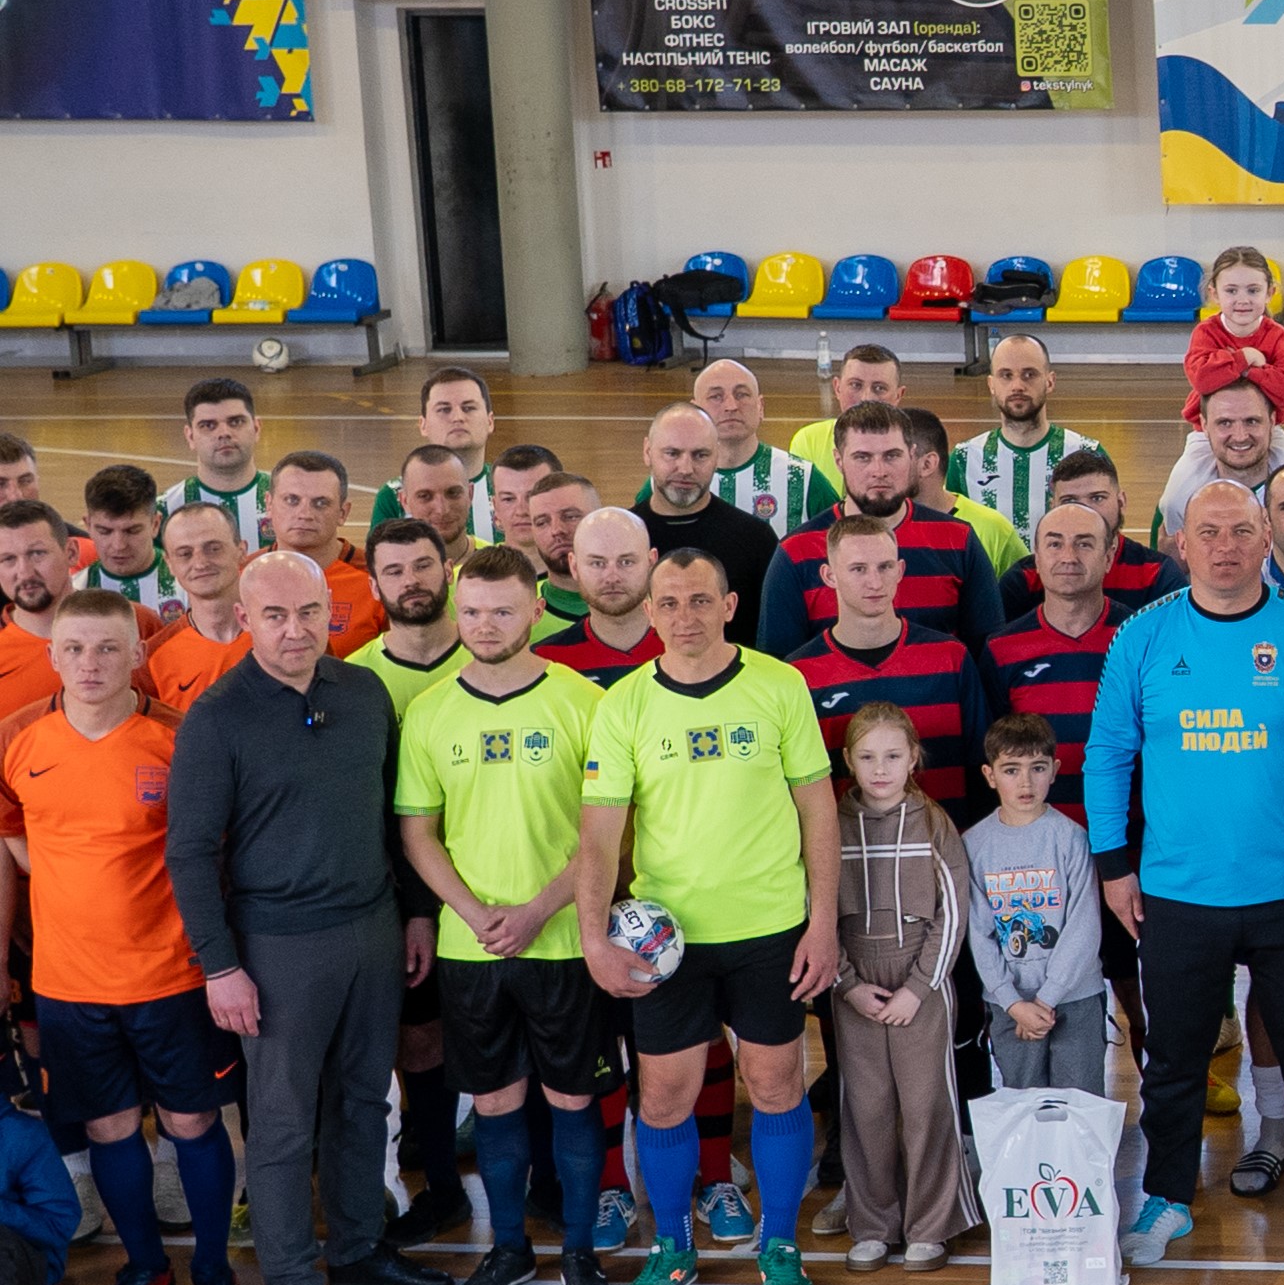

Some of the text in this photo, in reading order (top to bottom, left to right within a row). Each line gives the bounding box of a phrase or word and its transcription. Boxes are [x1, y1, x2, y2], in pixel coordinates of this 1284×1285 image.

[670, 15, 716, 29] БОКС
[807, 19, 874, 35] ІГРОВИЙ
[877, 21, 910, 35] ЗАЛ
[664, 33, 725, 47] ФІТНЕС
[785, 40, 1004, 56] волейбол/футбол/баскетбол
[622, 49, 771, 66] НАСТІЛЬНИЙ ТЕНІС
[864, 58, 928, 72] МАСАЖ
[630, 78, 781, 93] 380-68-172-71-23
[870, 77, 924, 91] САУНА
[1033, 79, 1094, 92] tekstylnyk
[1179, 708, 1245, 729] СИЛА
[1181, 723, 1268, 754] ЛЮДЕЙ
[984, 869, 1055, 893] READY
[1002, 1186, 1104, 1218] EVA
